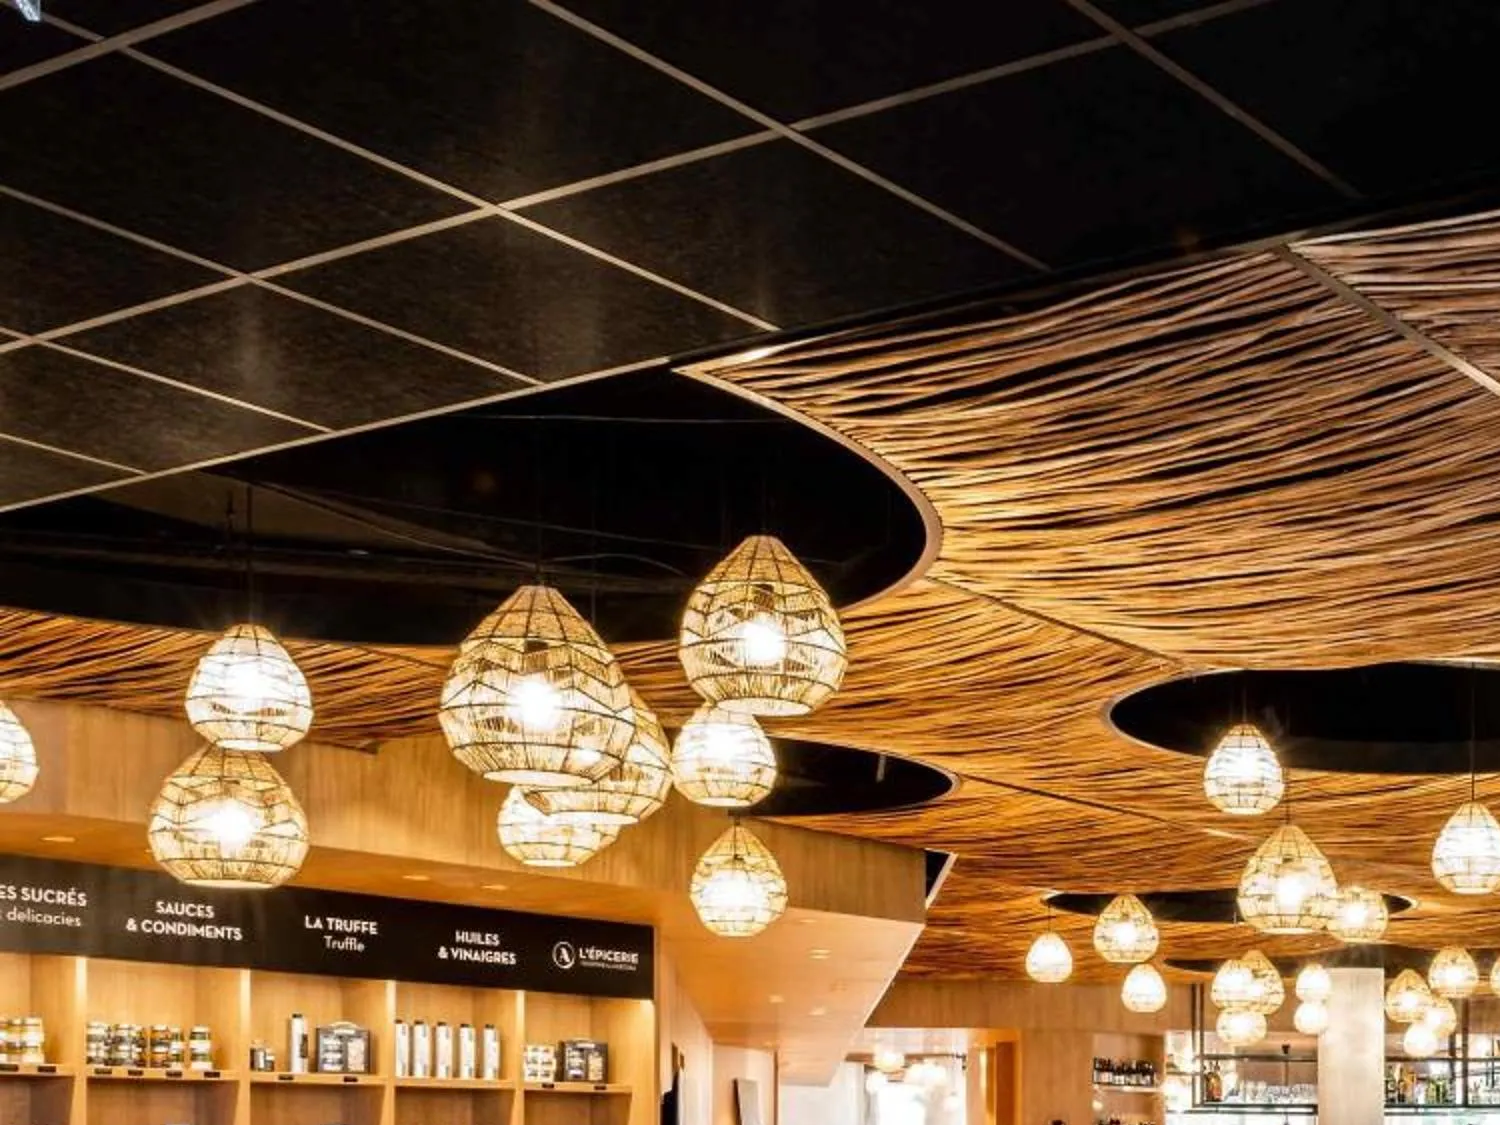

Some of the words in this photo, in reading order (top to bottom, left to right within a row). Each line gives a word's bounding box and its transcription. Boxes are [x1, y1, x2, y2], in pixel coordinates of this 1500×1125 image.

[20, 886, 88, 907] SUCRÉS
[7, 907, 82, 927] delicacies
[156, 901, 215, 919] SAUCES
[125, 918, 138, 932] &
[140, 919, 243, 941] CONDIMENTS
[304, 915, 323, 930] LA
[326, 917, 378, 935] TRUFFE
[323, 935, 366, 952] Truffle
[455, 930, 500, 947] HUILES
[438, 946, 449, 960] &
[451, 947, 517, 965] VINAIGRES
